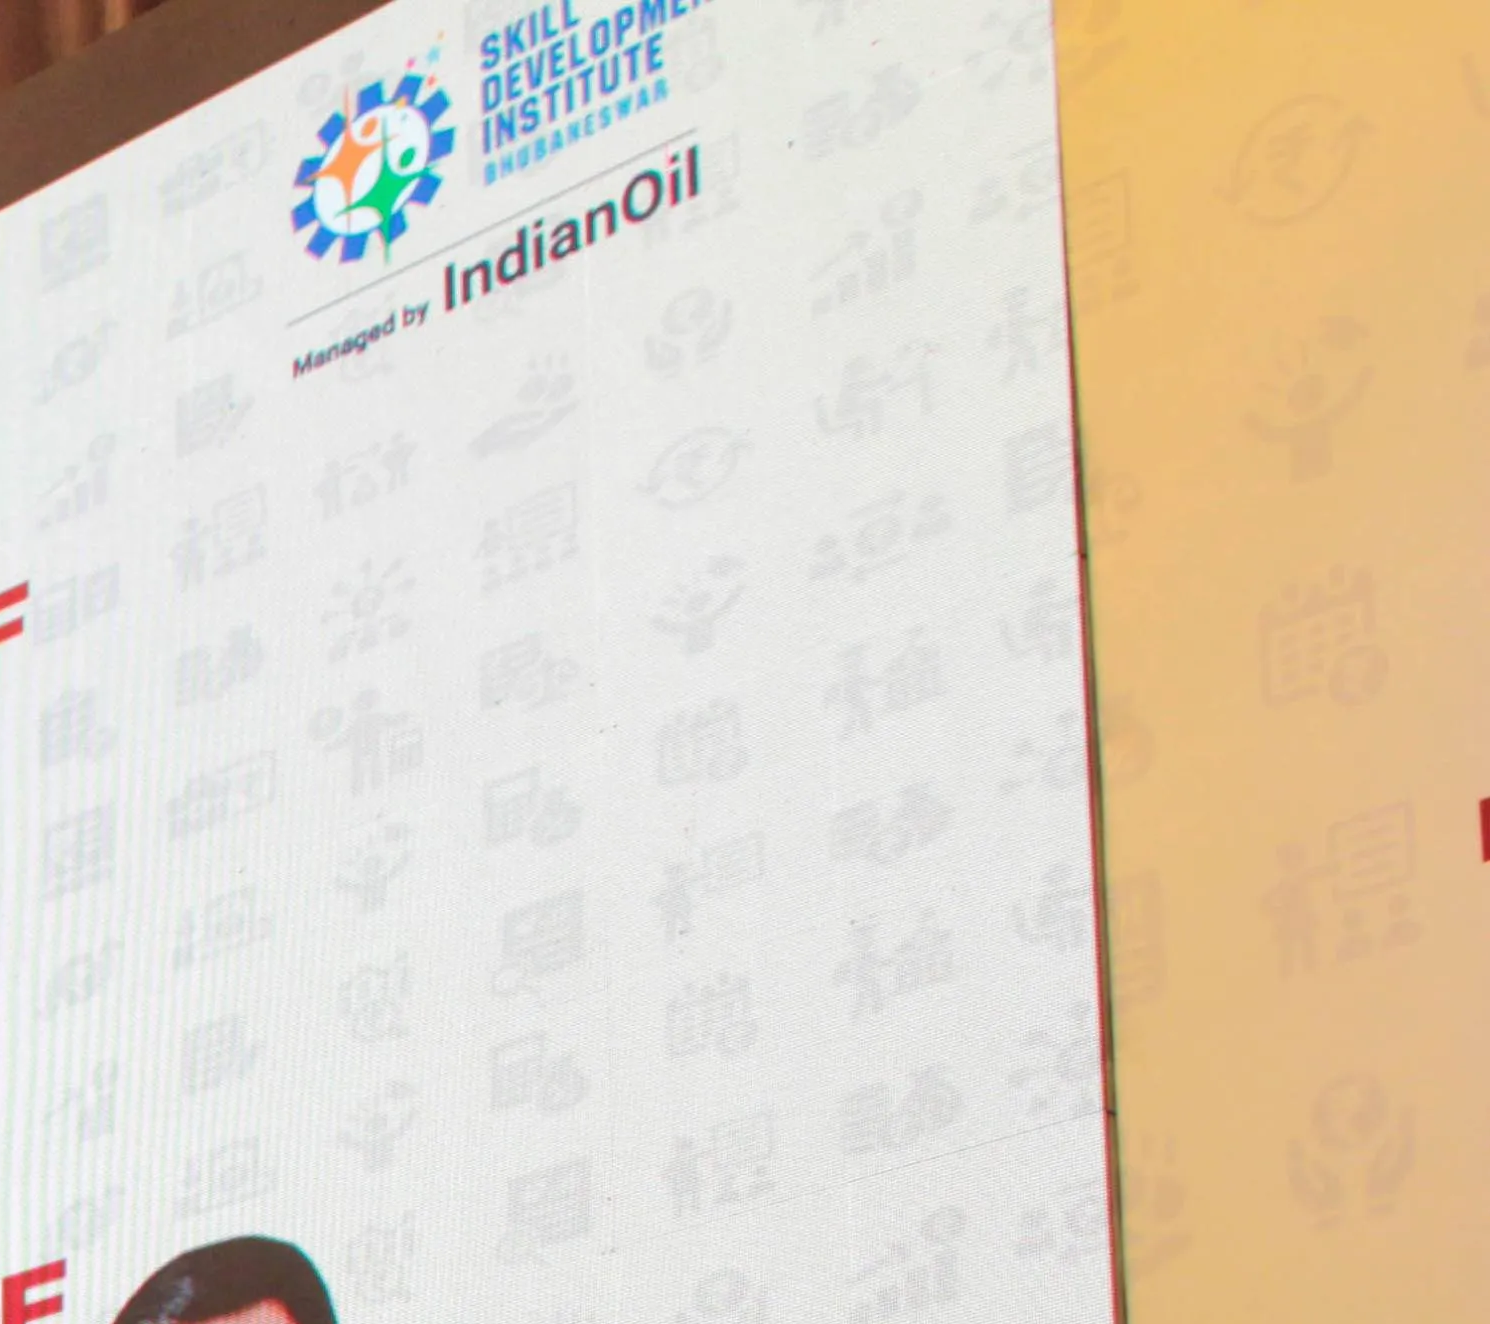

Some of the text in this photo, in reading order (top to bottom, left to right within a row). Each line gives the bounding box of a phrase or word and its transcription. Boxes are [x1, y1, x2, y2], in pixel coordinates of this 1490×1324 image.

[480, 0, 580, 70] SKILL
[481, 0, 713, 113] DEVELOPM
[482, 31, 664, 155] INSTITUTE
[484, 77, 669, 187] BHUBANESWAR
[292, 145, 701, 379] Managed by IndianOil
